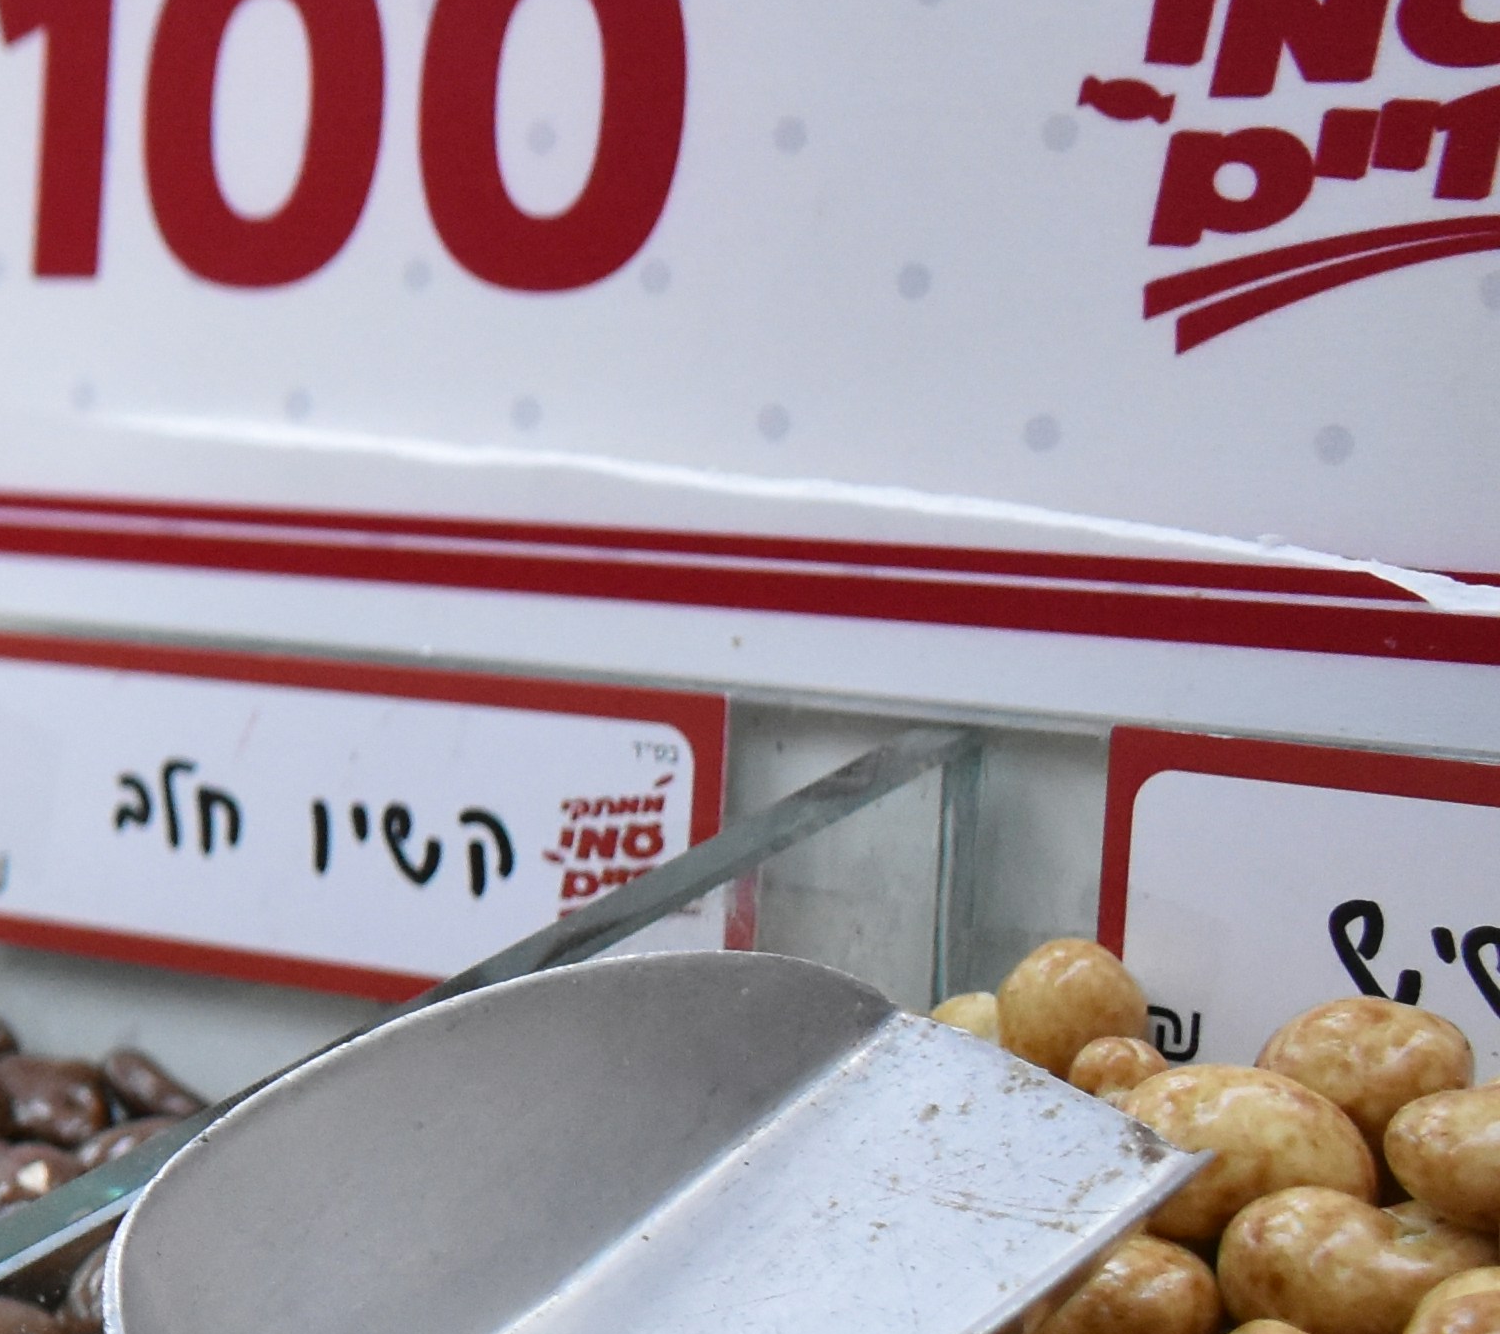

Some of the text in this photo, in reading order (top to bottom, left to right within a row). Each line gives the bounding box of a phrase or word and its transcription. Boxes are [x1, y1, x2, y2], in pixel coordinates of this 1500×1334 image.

[561, 793, 667, 820] ממתקי
[113, 757, 517, 899] קשיו חלב
[559, 822, 665, 861] סמי
